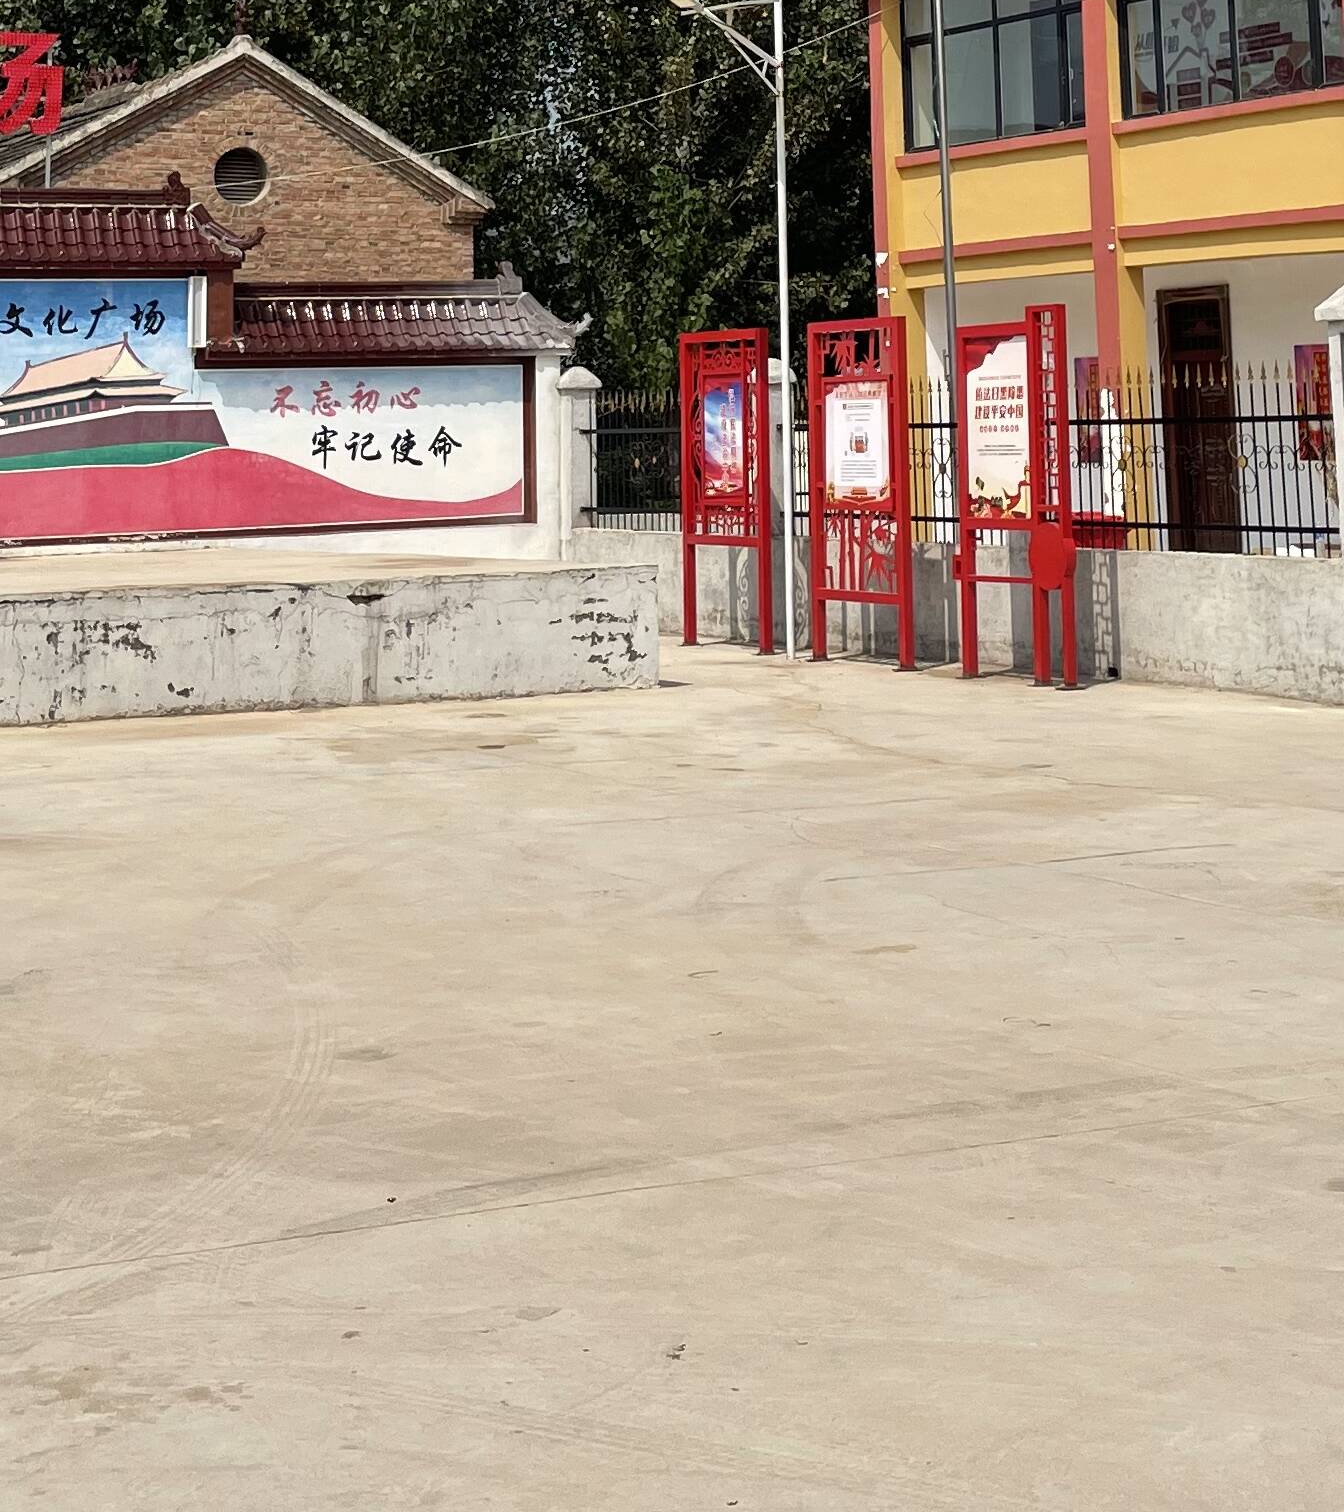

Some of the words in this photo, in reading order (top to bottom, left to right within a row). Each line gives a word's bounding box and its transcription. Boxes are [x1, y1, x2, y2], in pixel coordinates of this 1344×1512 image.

[269, 382, 420, 419] 不忘初心
[311, 425, 463, 471] 牢记使命
